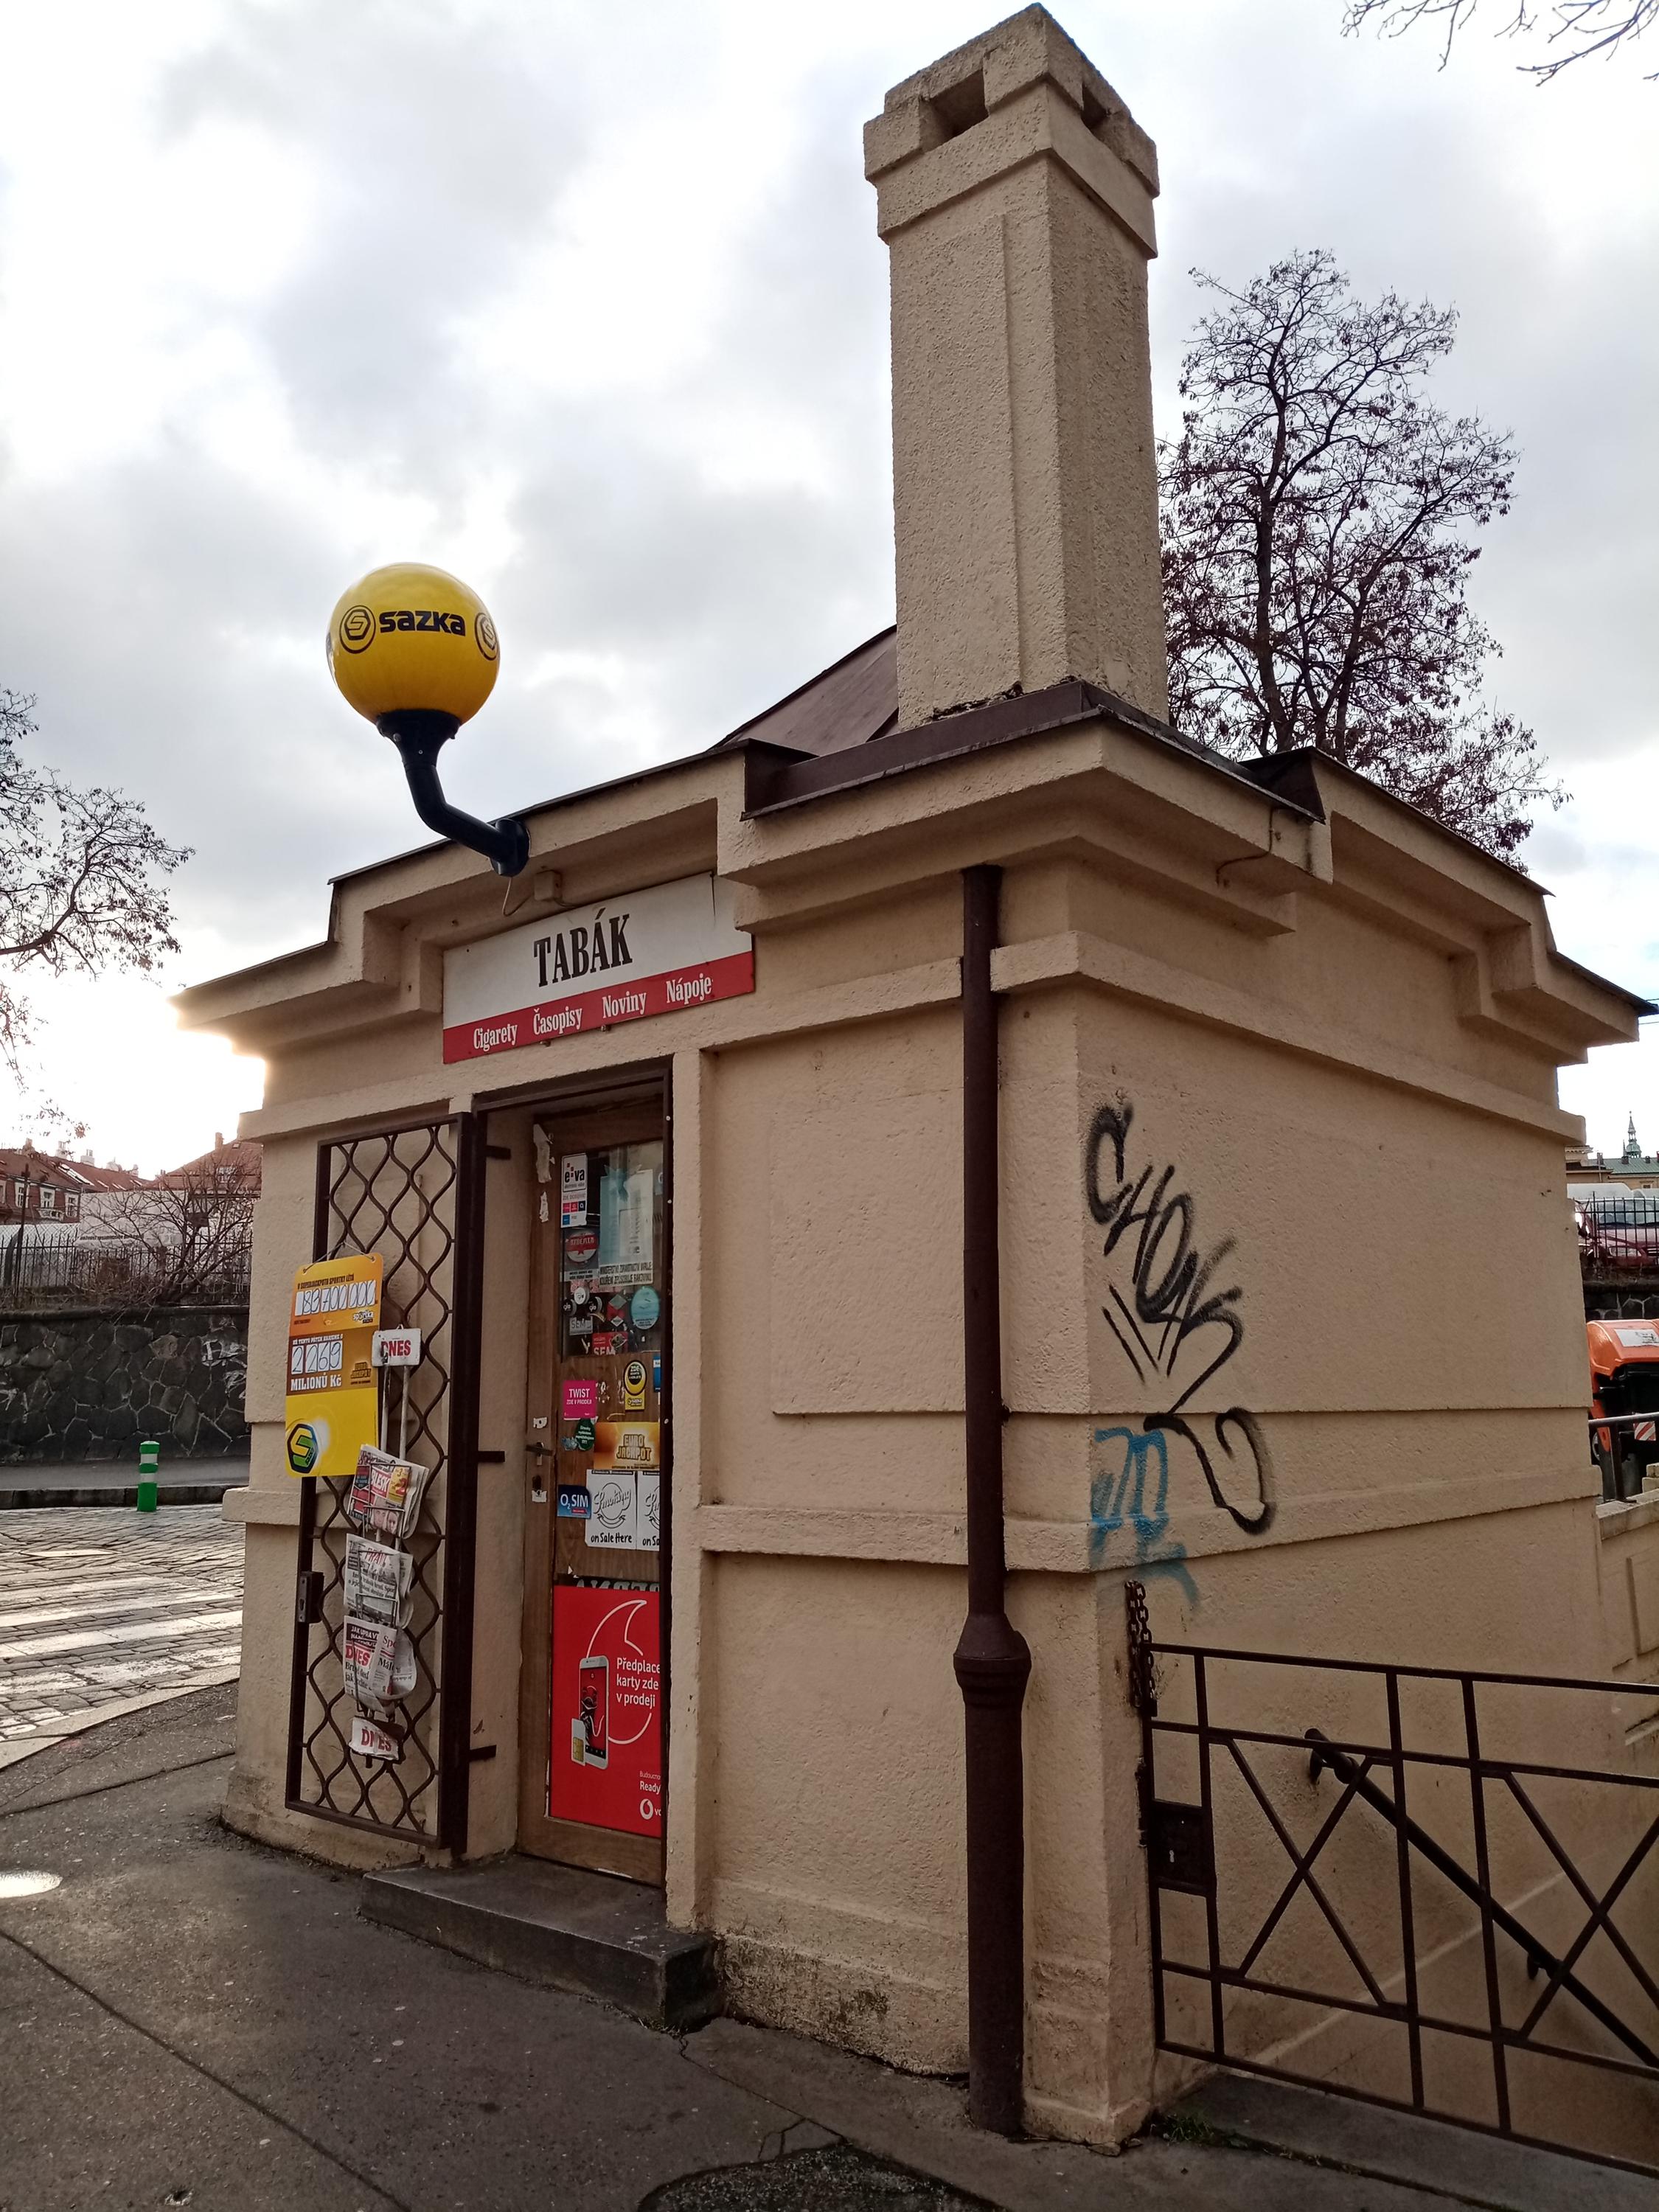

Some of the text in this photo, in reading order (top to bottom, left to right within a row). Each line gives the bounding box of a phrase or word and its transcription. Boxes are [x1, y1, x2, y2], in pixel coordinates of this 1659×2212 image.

[533, 907, 633, 988] TABÁK
[473, 973, 712, 1051] Cigarety Časopisy Noviny Nápoje
[380, 1340, 411, 1357] DNES
[568, 1388, 590, 1398] TWIST
[571, 1495, 588, 1508] SIM
[600, 1533, 613, 1543] Sale
[615, 1533, 632, 1543] Here
[616, 1674, 658, 1691] karty zde
[616, 1692, 655, 1709] v prodeji
[639, 1781, 661, 1795] Ready
